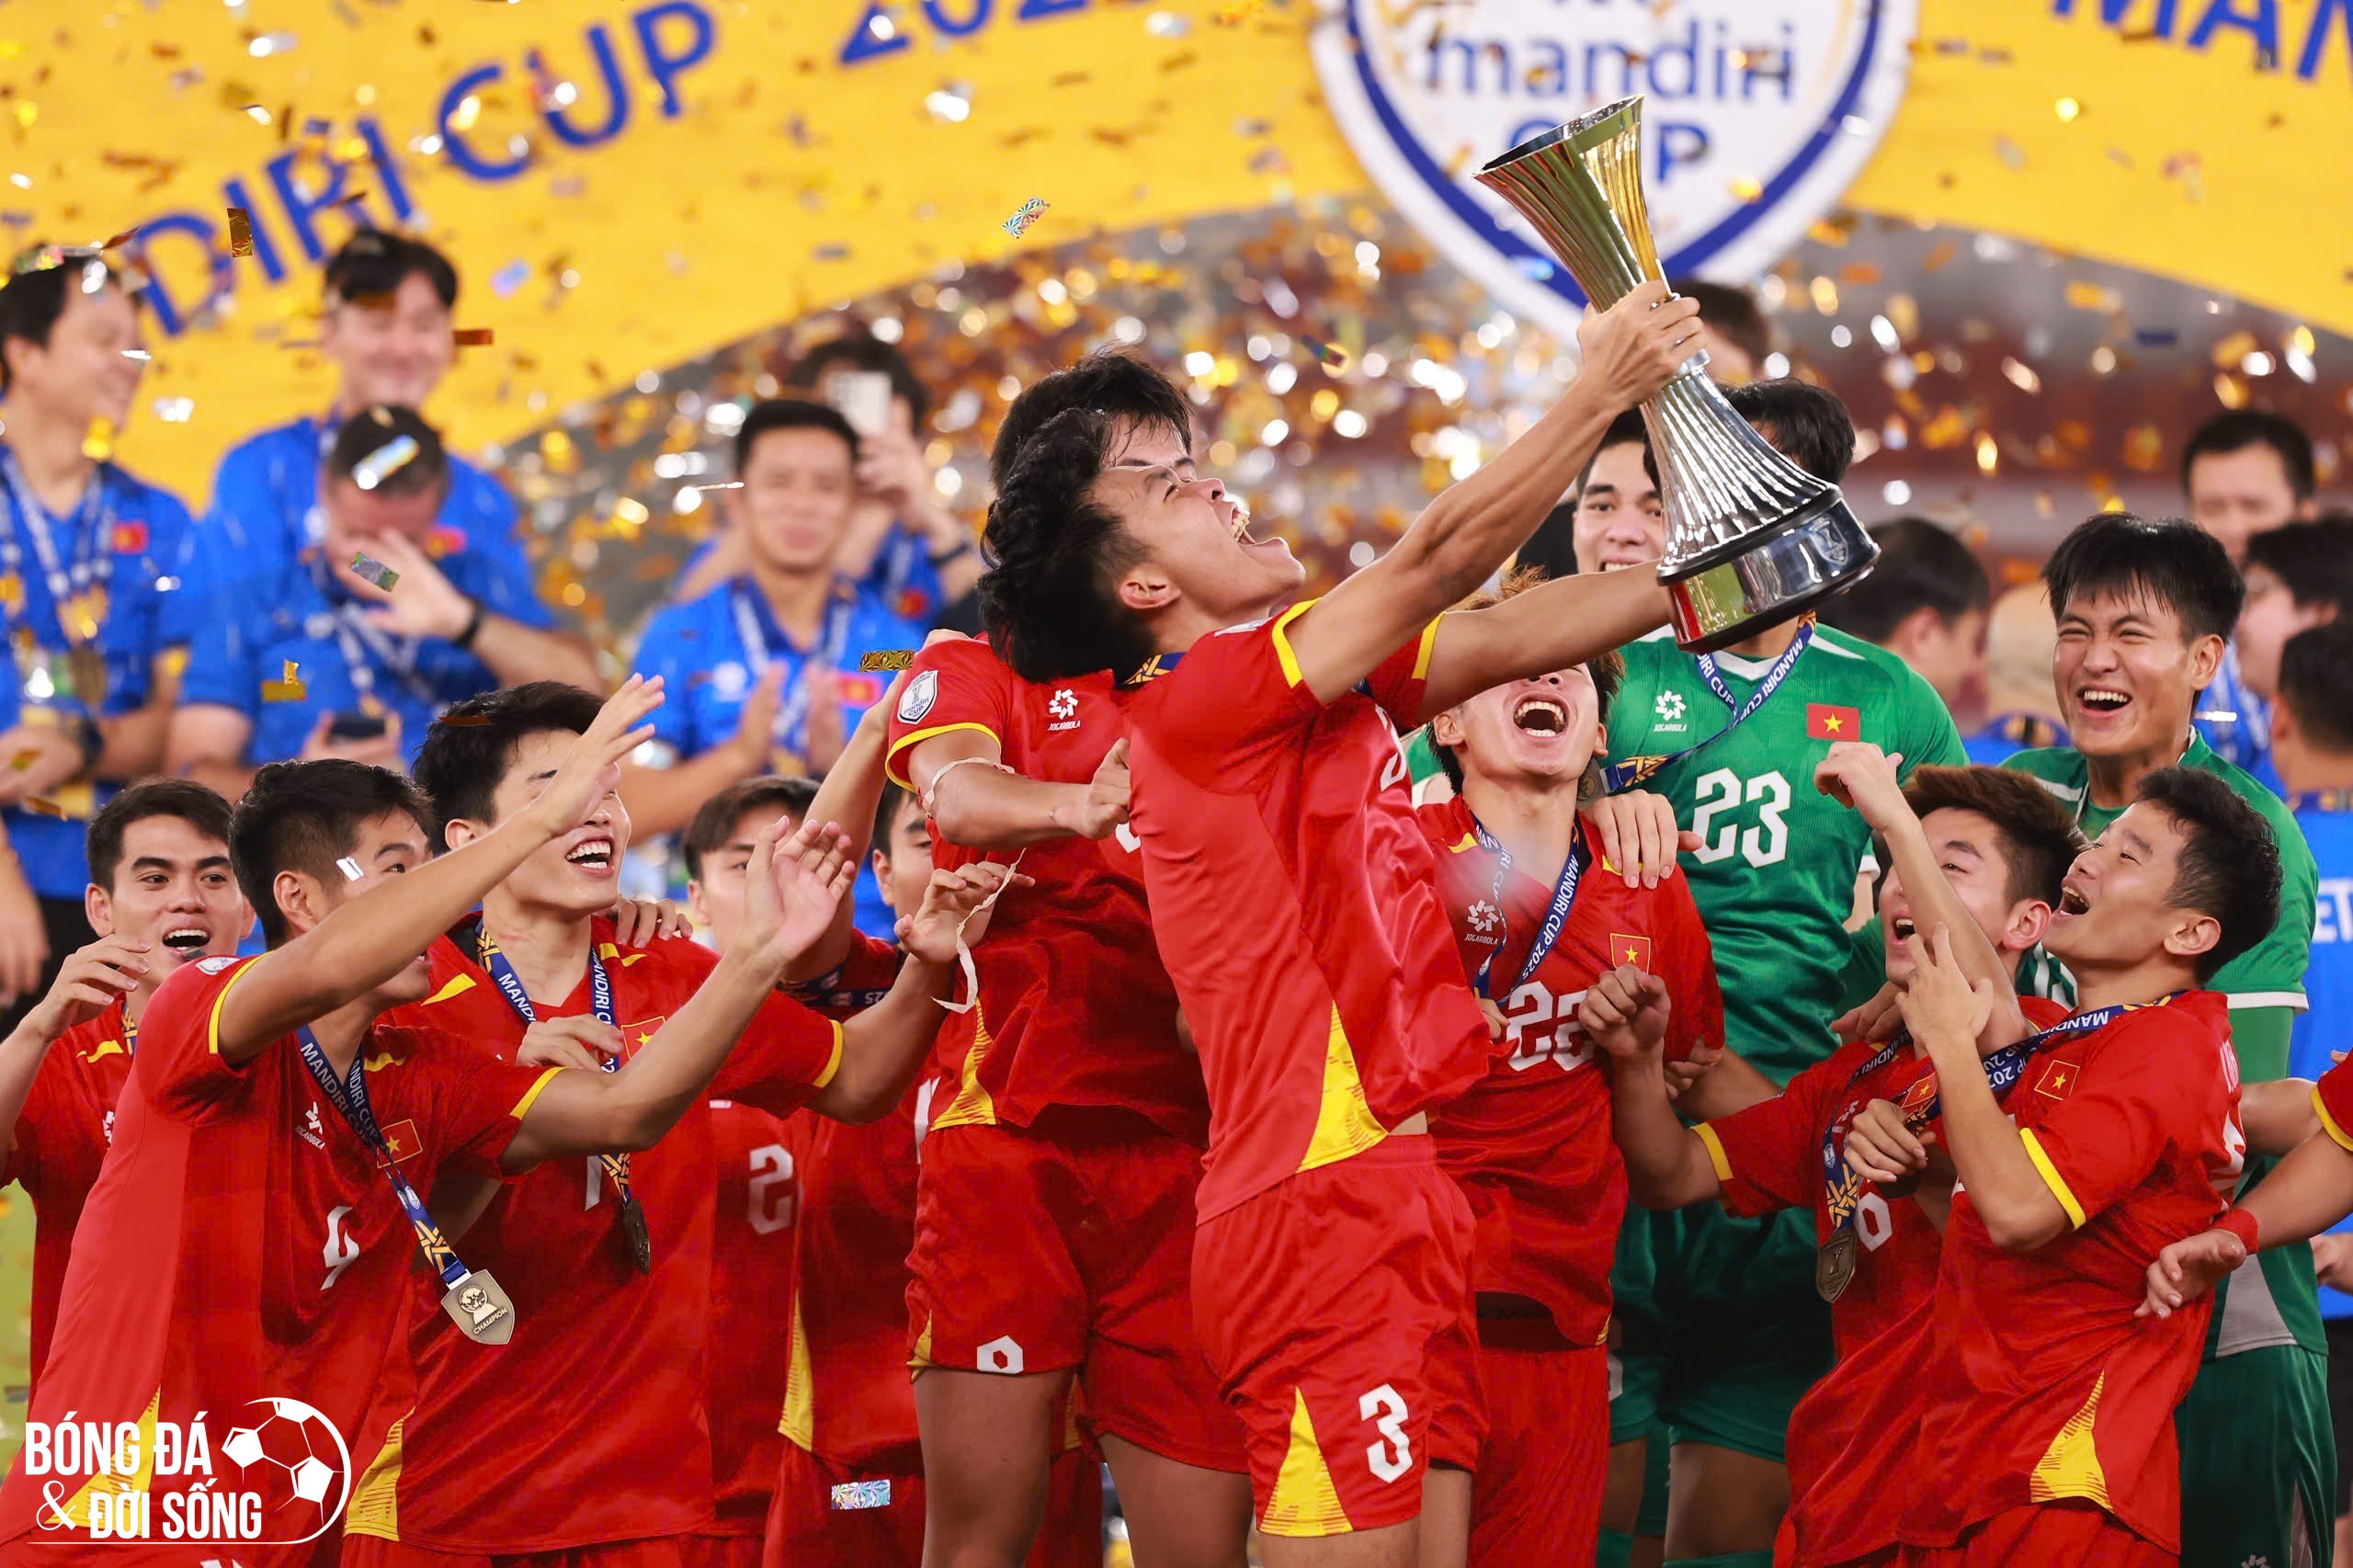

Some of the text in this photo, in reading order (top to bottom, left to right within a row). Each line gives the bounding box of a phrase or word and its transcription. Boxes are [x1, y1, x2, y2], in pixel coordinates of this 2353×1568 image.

[436, 1, 716, 181] CUP
[1427, 17, 1793, 97] mandiri
[1711, 676, 1734, 707] CUP
[1740, 638, 1803, 722] MANDIRI CUP
[1691, 767, 1791, 869] 23
[1521, 854, 1579, 981] MANDIRI CUP 2025
[301, 1042, 349, 1113] MANDIRI
[472, 1306, 508, 1335] CHAMPION
[1358, 1382, 1414, 1483] 3
